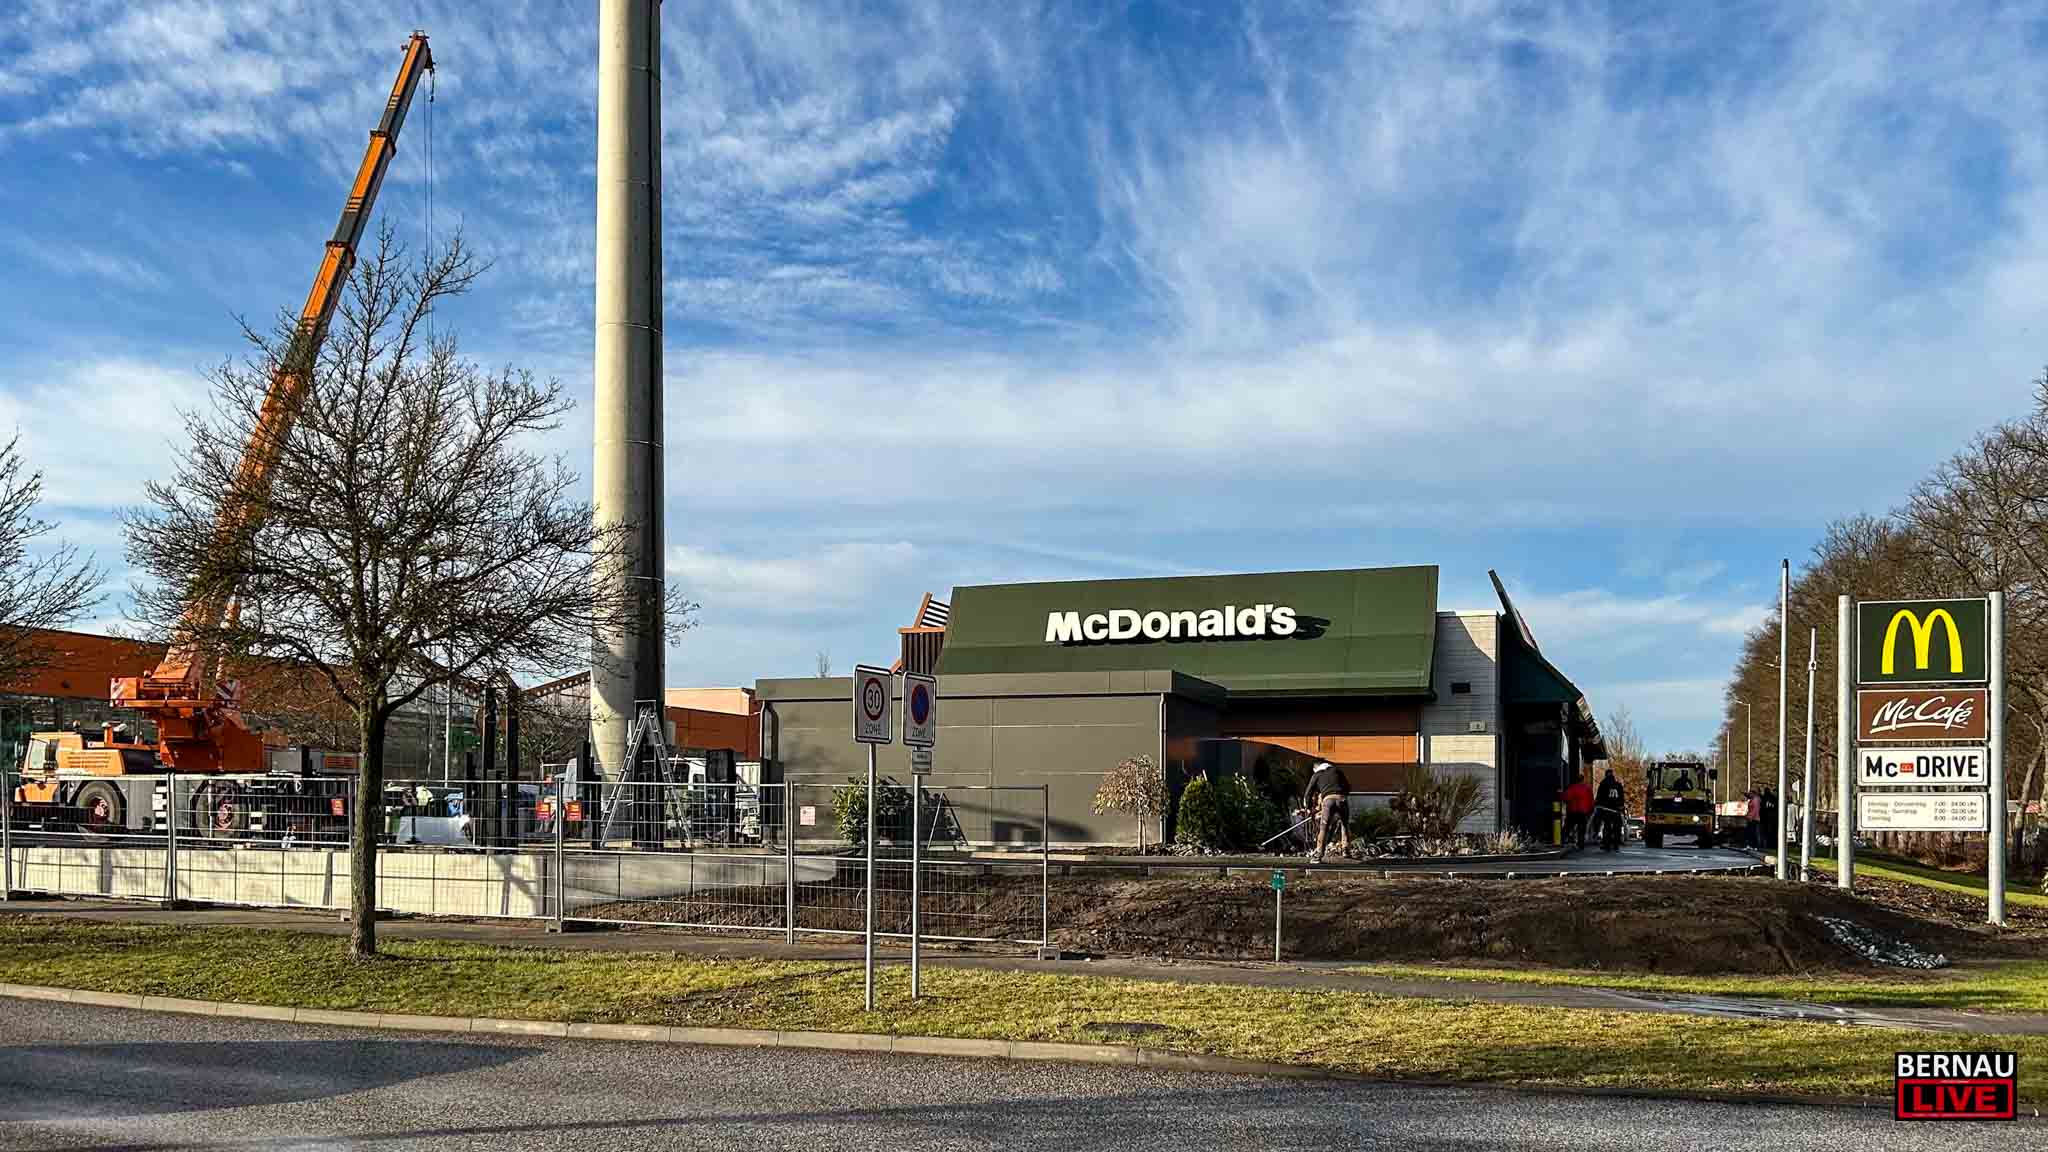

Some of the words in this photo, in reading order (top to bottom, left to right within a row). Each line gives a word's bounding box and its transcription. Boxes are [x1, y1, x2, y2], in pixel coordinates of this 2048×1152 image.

[1045, 603, 1297, 642] McDonald's
[866, 688, 881, 710] 30
[1871, 696, 1975, 730] McCafé
[1916, 755, 1979, 778] DRIVE
